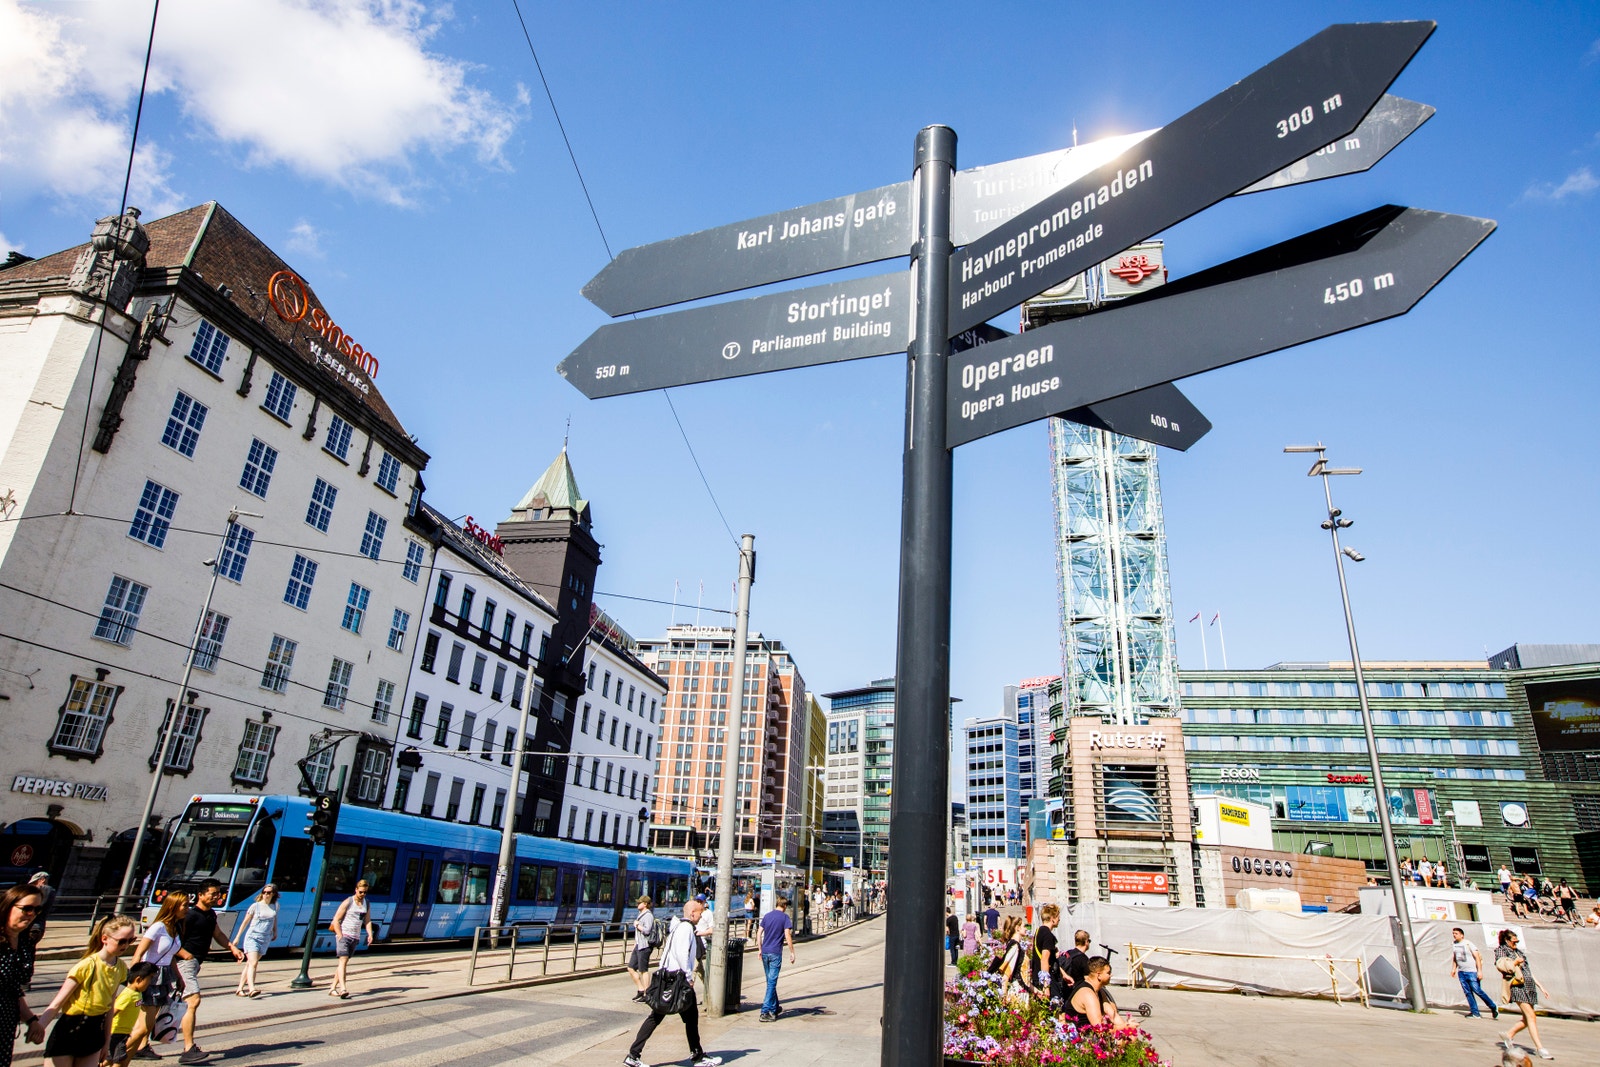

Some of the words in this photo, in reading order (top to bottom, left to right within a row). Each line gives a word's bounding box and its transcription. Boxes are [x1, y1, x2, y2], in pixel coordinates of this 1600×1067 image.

[1276, 105, 1314, 138] 300
[1323, 94, 1342, 114] m
[1344, 138, 1360, 150] m
[737, 226, 774, 250] Karl
[780, 211, 845, 241] Johans
[854, 199, 896, 227] gate
[962, 159, 1154, 282] Havnepromenaden
[962, 272, 1015, 310] Harbour
[1020, 224, 1104, 279] Promenade
[1324, 278, 1363, 304] 450
[1374, 272, 1395, 290] m
[788, 287, 892, 323] Stortinget
[308, 308, 379, 379] SYNSAM
[752, 329, 827, 354] Parliament
[833, 320, 891, 342] Building
[596, 366, 616, 379] 550
[620, 364, 630, 376] m
[962, 344, 1054, 391] Operaen
[962, 393, 1004, 420] Opera
[1011, 376, 1060, 402] House
[1151, 414, 1168, 429] 400
[1171, 422, 1180, 432] m
[463, 515, 506, 557] Scandic
[1089, 730, 1166, 750] Ruter#
[12, 776, 72, 797] PEPPES
[72, 783, 109, 801] PIZZA
[1220, 768, 1259, 779] EGON
[1327, 773, 1369, 784] Scandic
[200, 808, 210, 818] 13
[1418, 791, 1428, 813] name
